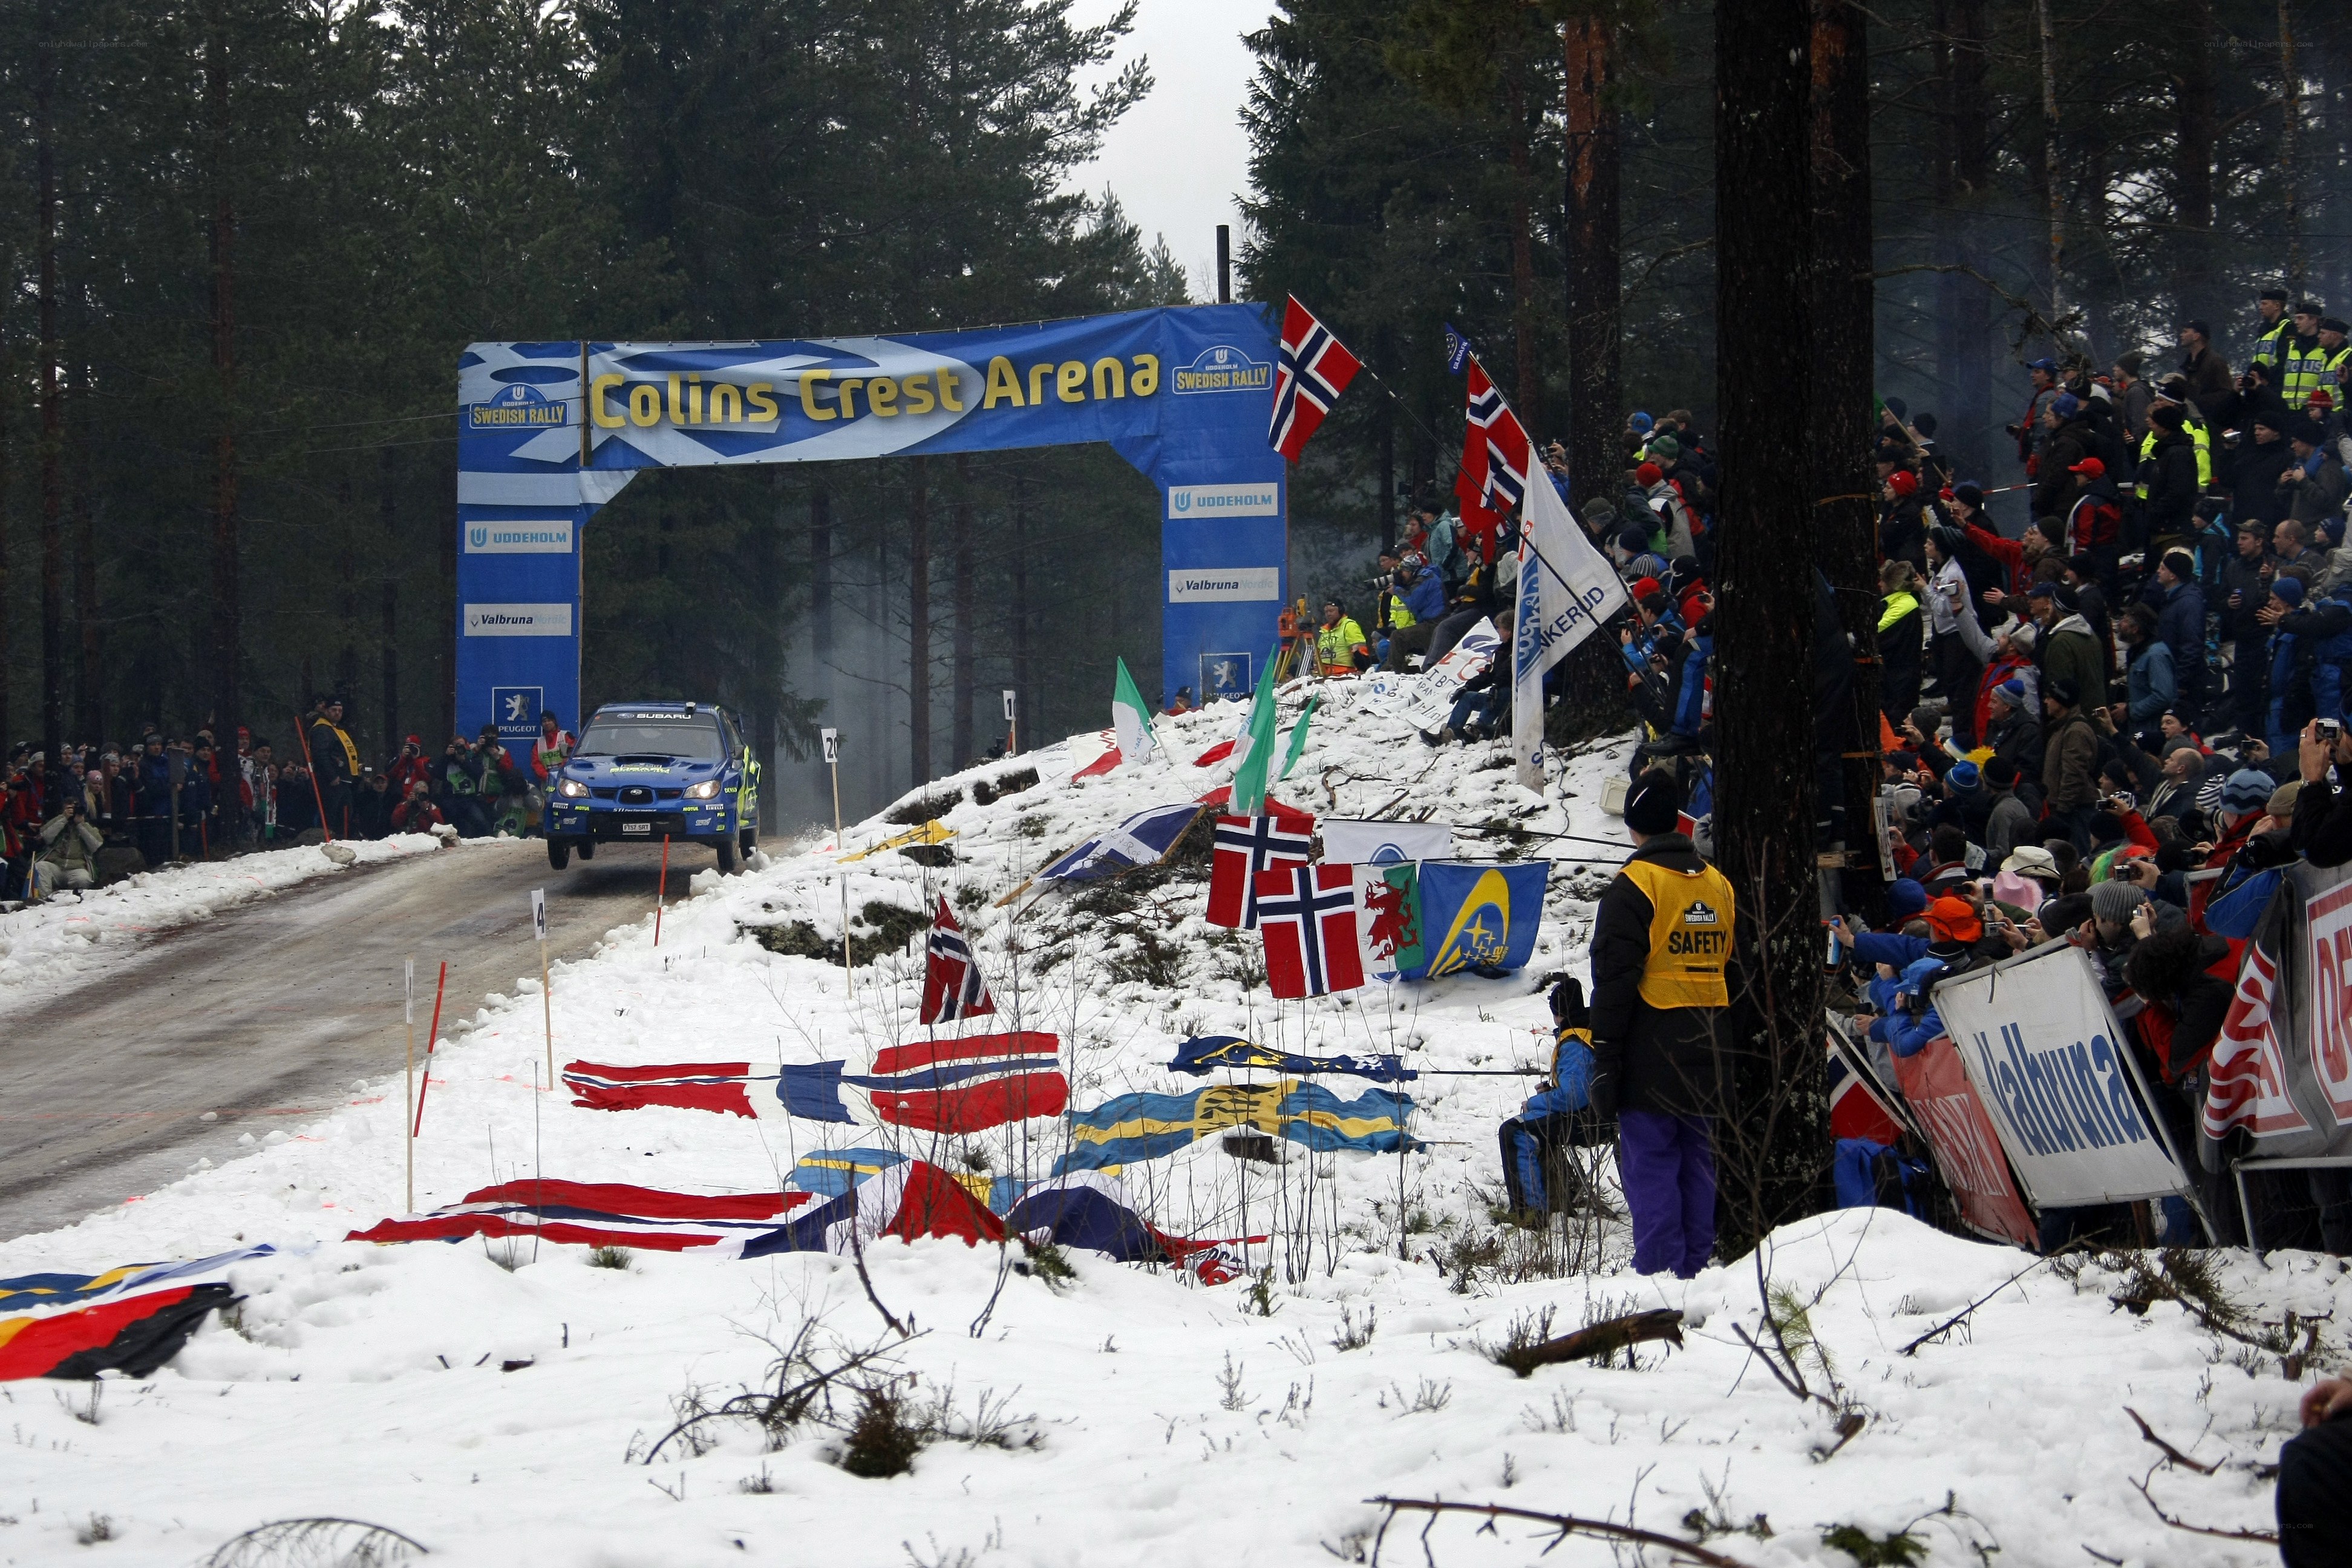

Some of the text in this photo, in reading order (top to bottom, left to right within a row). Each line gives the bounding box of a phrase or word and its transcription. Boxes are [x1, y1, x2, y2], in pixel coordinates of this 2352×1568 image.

[1177, 367, 1268, 390] SWEDISH RALLY
[591, 354, 1158, 428] Colins Crest Arena
[474, 405, 564, 424] SWEDISH RALLY
[1197, 494, 1272, 507] UDDEHOLM
[493, 532, 567, 543] UDDEHOLM
[1186, 580, 1239, 590] Valbruna
[481, 614, 534, 624] Valbruna
[537, 902, 544, 933] 4
[1668, 930, 1726, 955] SAFETY
[1972, 1022, 2148, 1156] Valbruna
